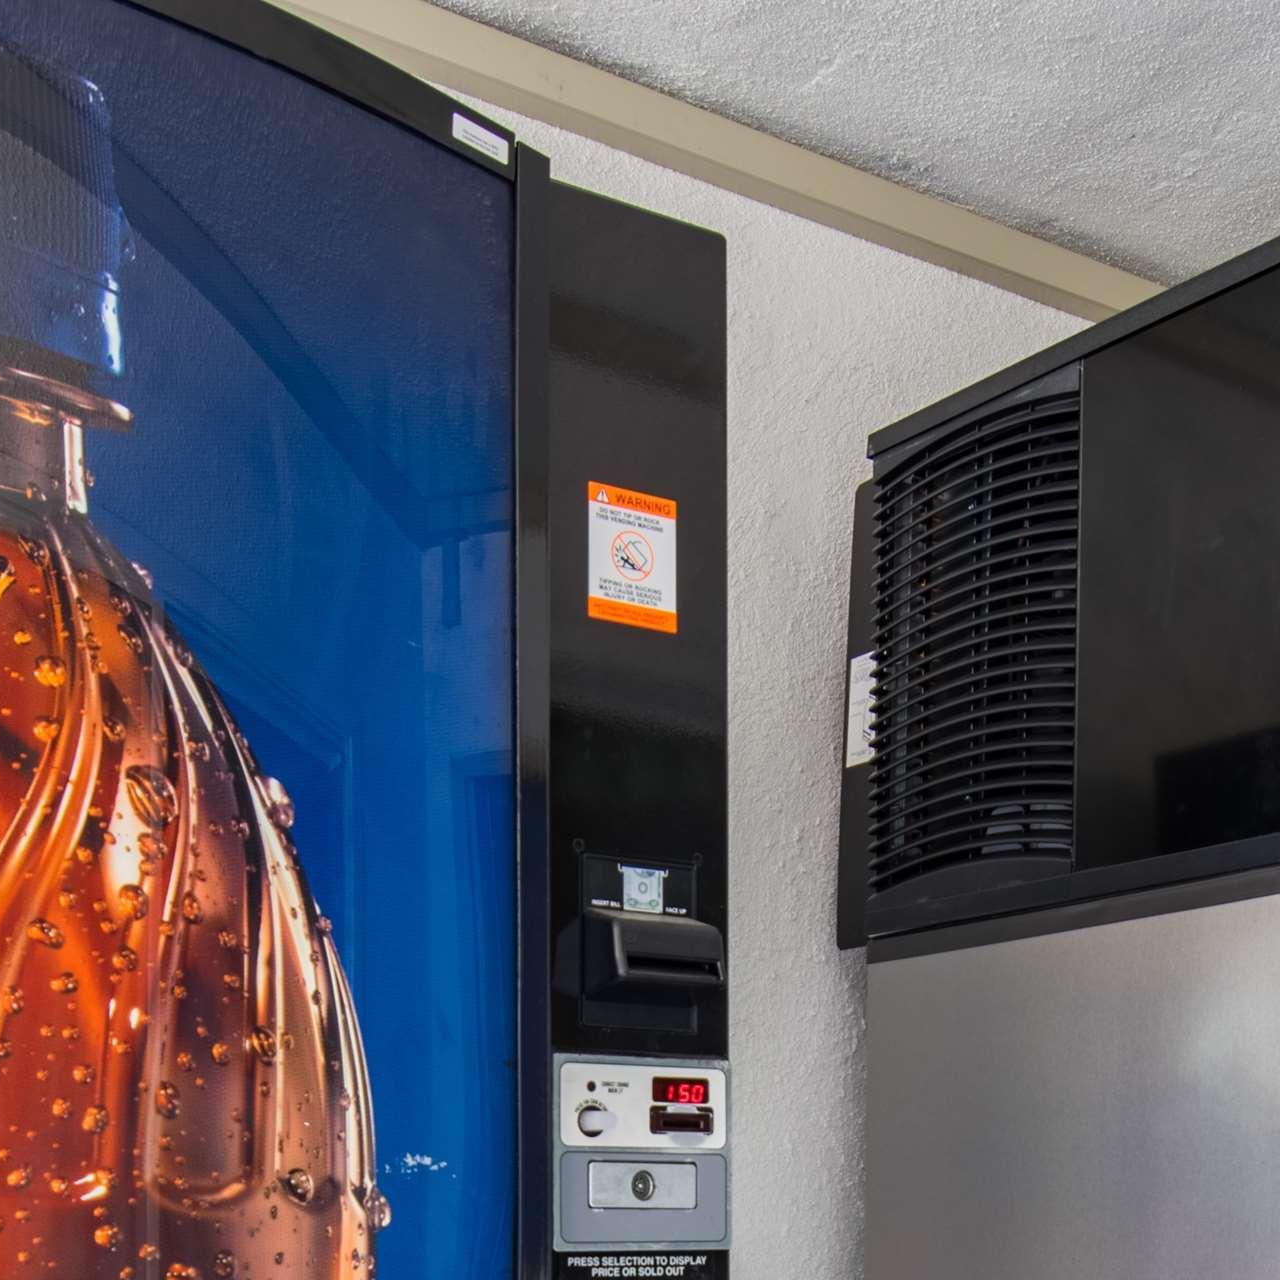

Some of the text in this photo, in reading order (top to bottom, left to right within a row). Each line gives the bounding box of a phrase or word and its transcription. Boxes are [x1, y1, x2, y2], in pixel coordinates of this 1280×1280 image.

[615, 493, 671, 515] WARNING
[611, 515, 636, 526] VENDING
[567, 1256, 707, 1267] PRESS SELECTION TO DISPLAY
[591, 1266, 685, 1277] PRICE OR SOLD OUT
